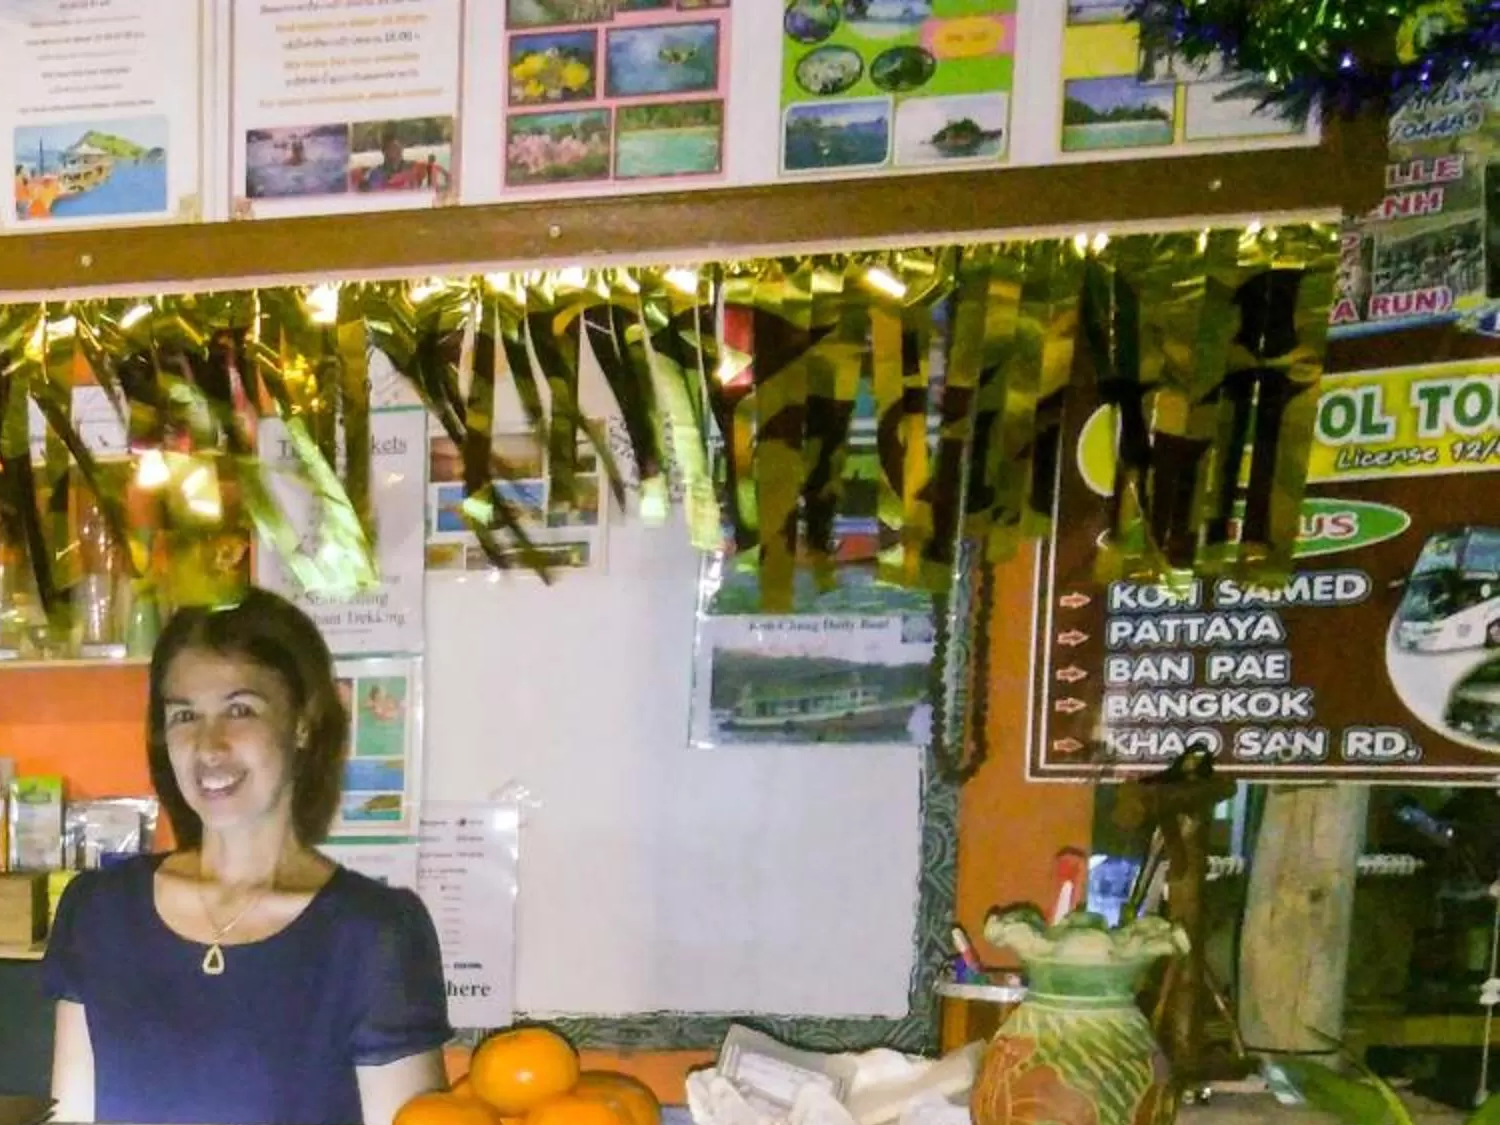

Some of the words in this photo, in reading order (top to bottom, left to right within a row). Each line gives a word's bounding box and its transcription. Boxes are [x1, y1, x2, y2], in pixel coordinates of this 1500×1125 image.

[1415, 378, 1500, 436] TO
[1336, 446, 1438, 470] License
[1299, 511, 1359, 542] US
[1107, 613, 1283, 646] PATTAYA
[1106, 655, 1191, 683] BAN
[1208, 652, 1288, 681] PAE
[1105, 690, 1312, 719] BANGKOK
[1105, 730, 1220, 757] KHAO
[1236, 729, 1325, 757] SAN
[1345, 729, 1420, 758] RD.
